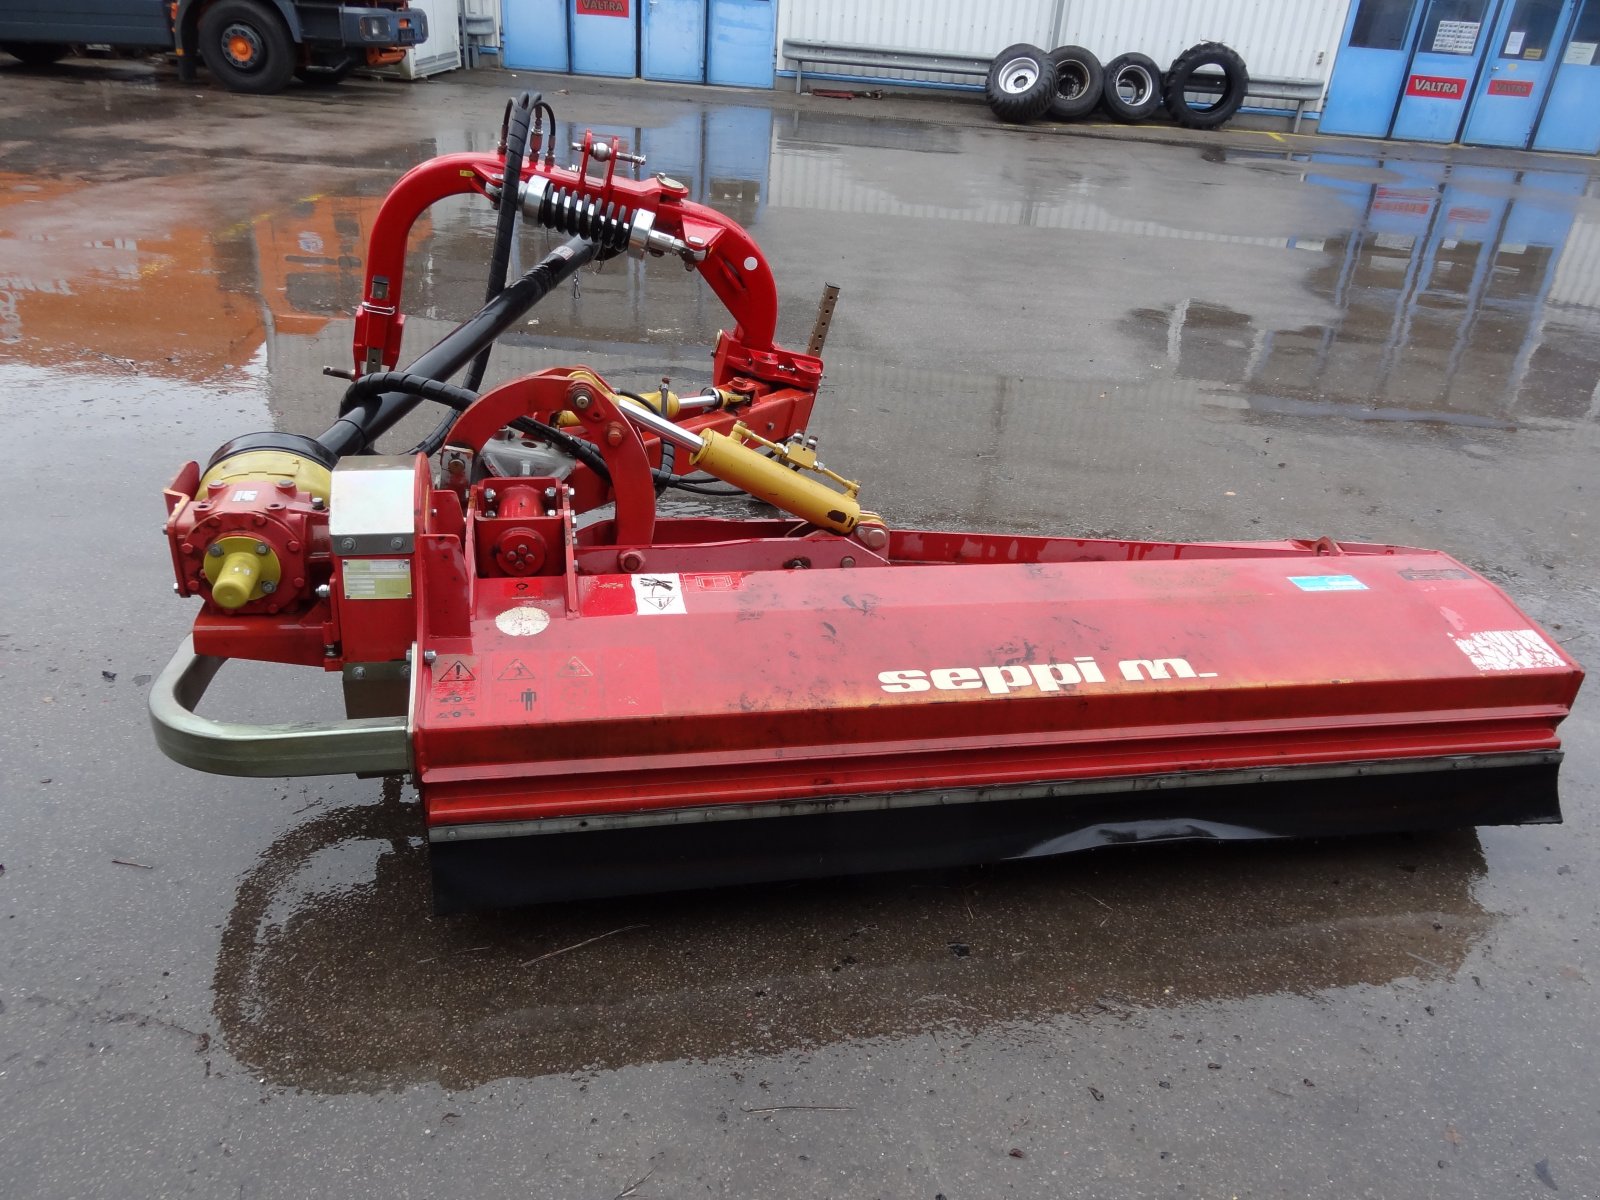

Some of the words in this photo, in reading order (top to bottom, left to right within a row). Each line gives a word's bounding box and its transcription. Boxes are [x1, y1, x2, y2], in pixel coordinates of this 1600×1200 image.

[582, 0, 624, 11] VALTRA
[1414, 79, 1458, 94] VALTRA
[877, 656, 1106, 694] seppi
